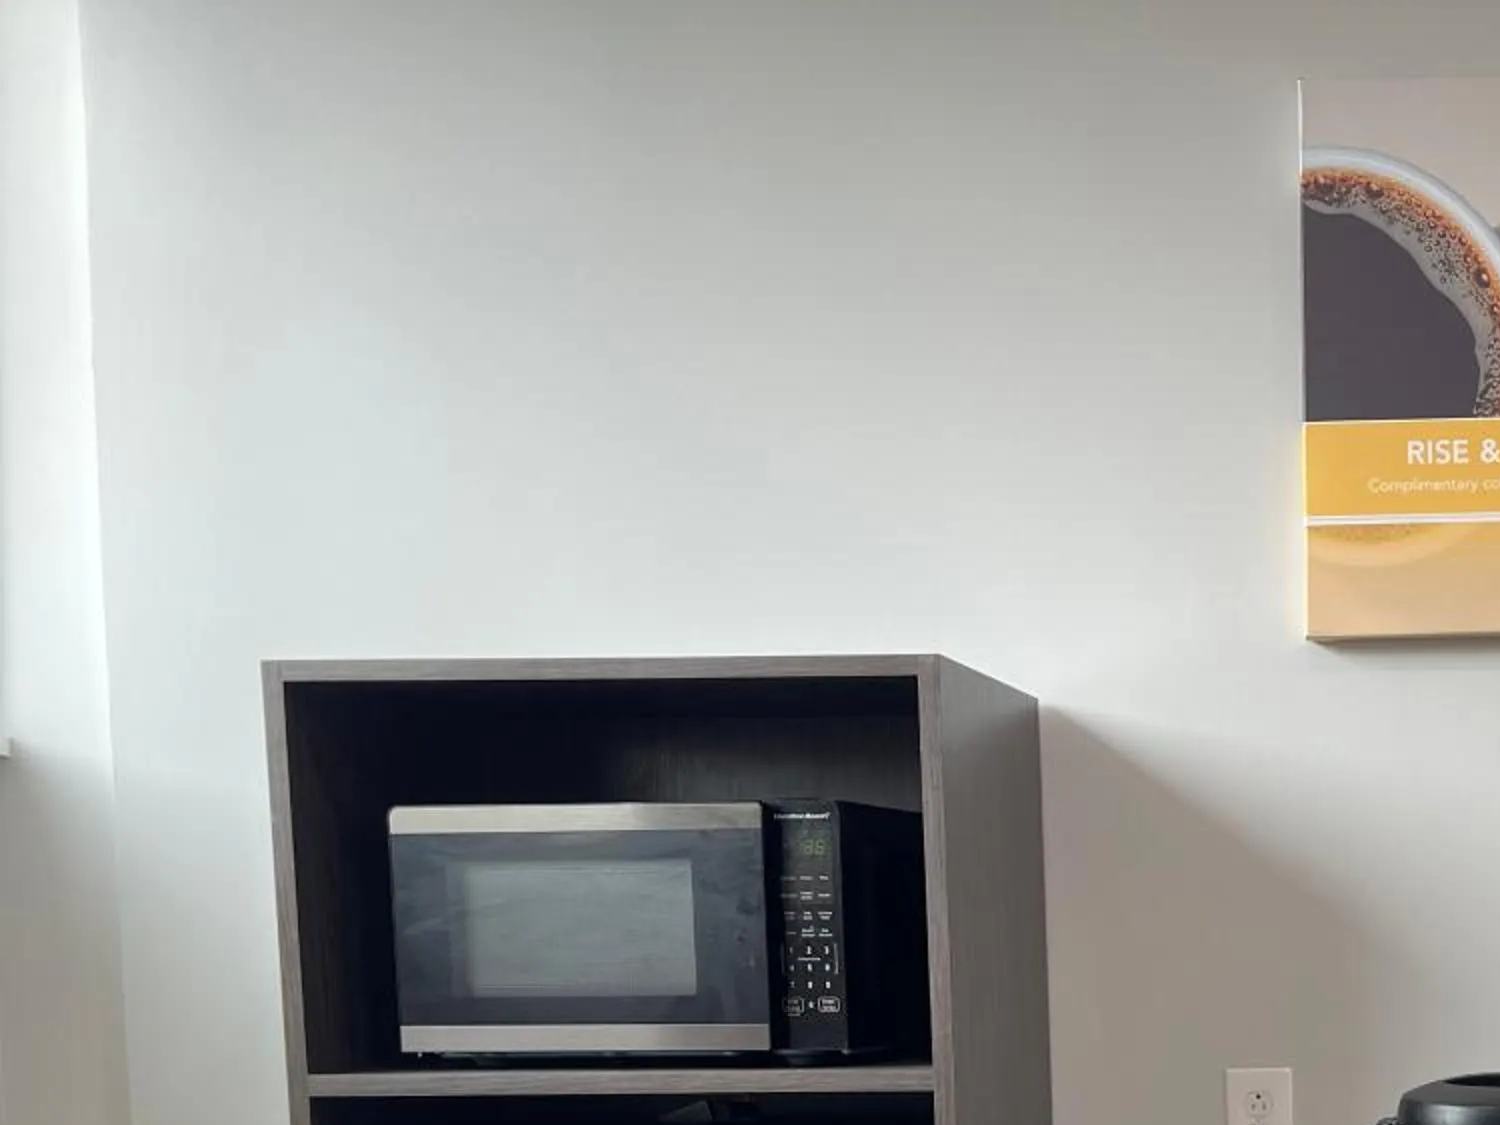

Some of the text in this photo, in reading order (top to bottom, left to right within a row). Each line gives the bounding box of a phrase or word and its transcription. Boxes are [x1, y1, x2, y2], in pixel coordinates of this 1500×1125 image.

[1407, 438, 1469, 465] RISE
[1480, 438, 1500, 463] &
[1367, 476, 1479, 494] Complimentary
